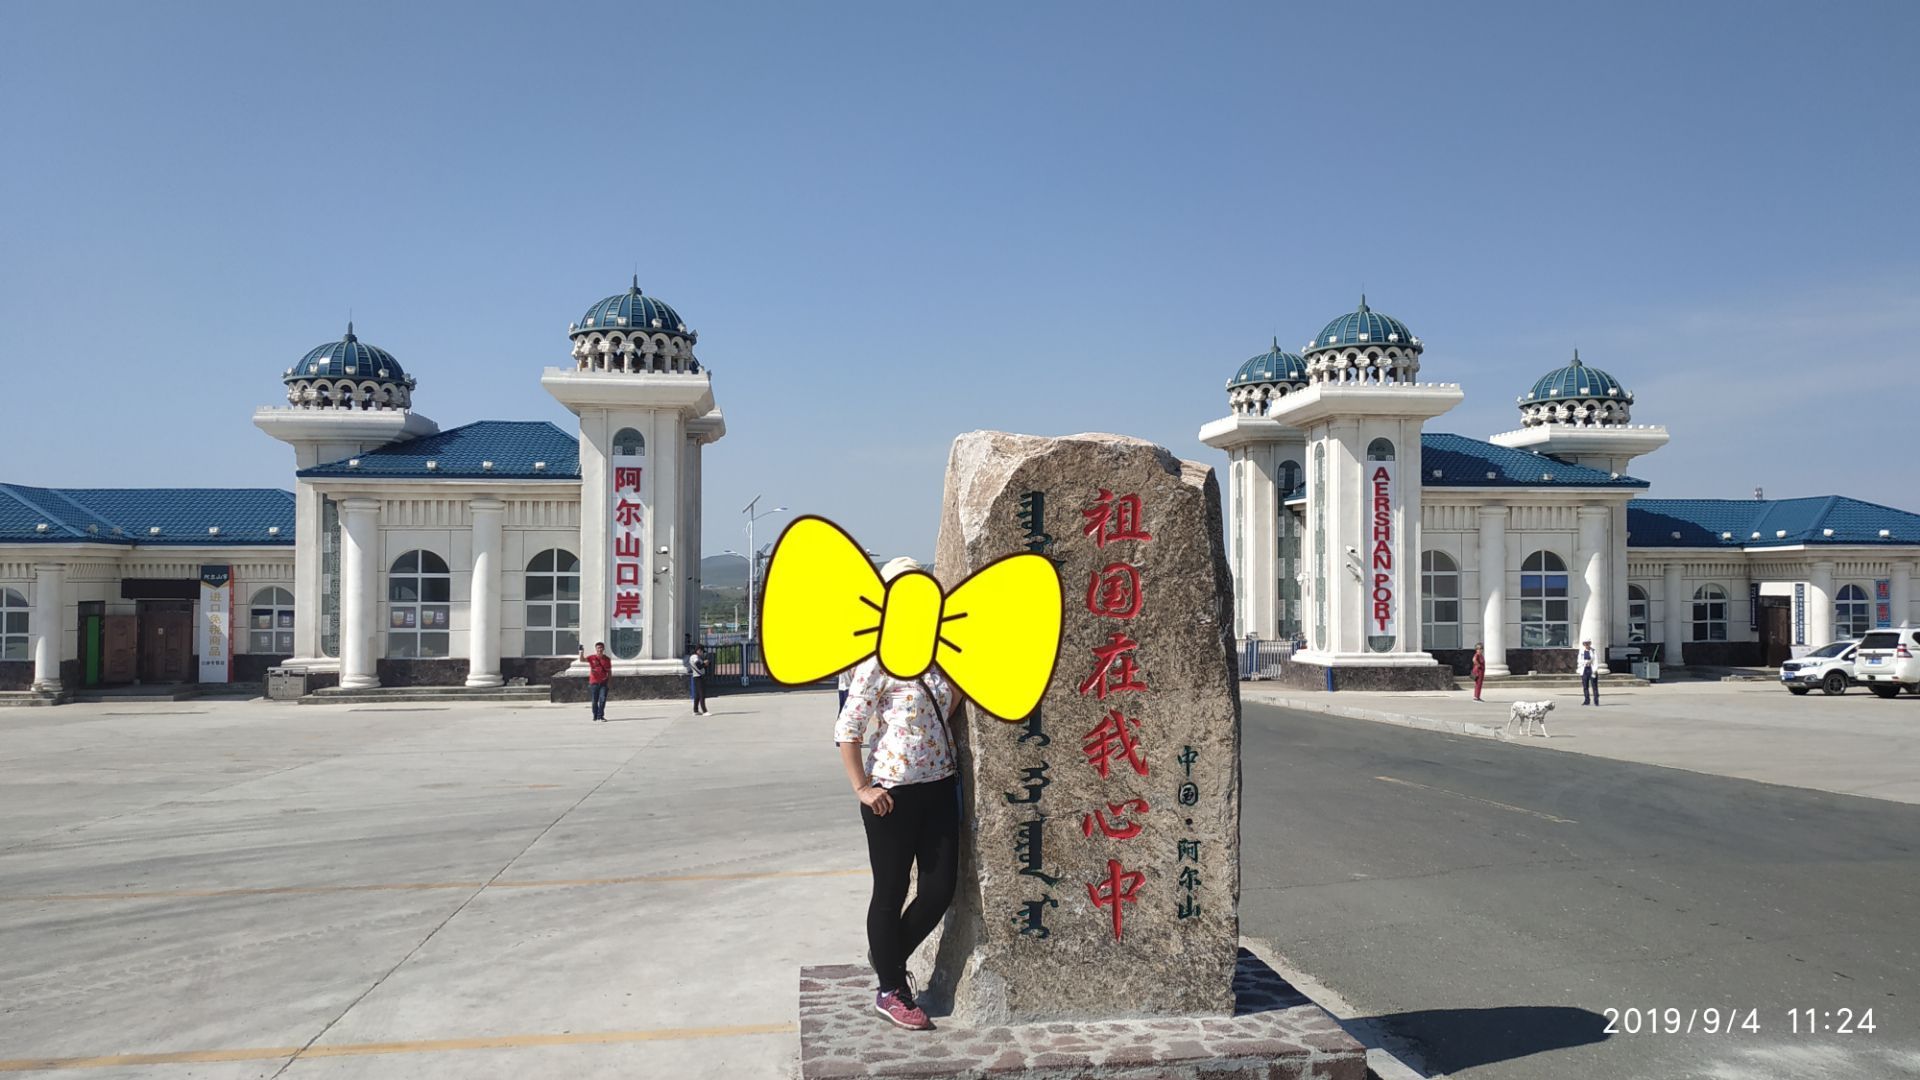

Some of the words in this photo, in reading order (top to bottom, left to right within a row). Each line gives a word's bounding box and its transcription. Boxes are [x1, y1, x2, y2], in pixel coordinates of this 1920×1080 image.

[613, 467, 643, 620] 阿尔山口岸
[1372, 466, 1392, 569] AERSHAN
[1373, 574, 1392, 631] PORT
[1079, 488, 1153, 943] 祖国在我心中
